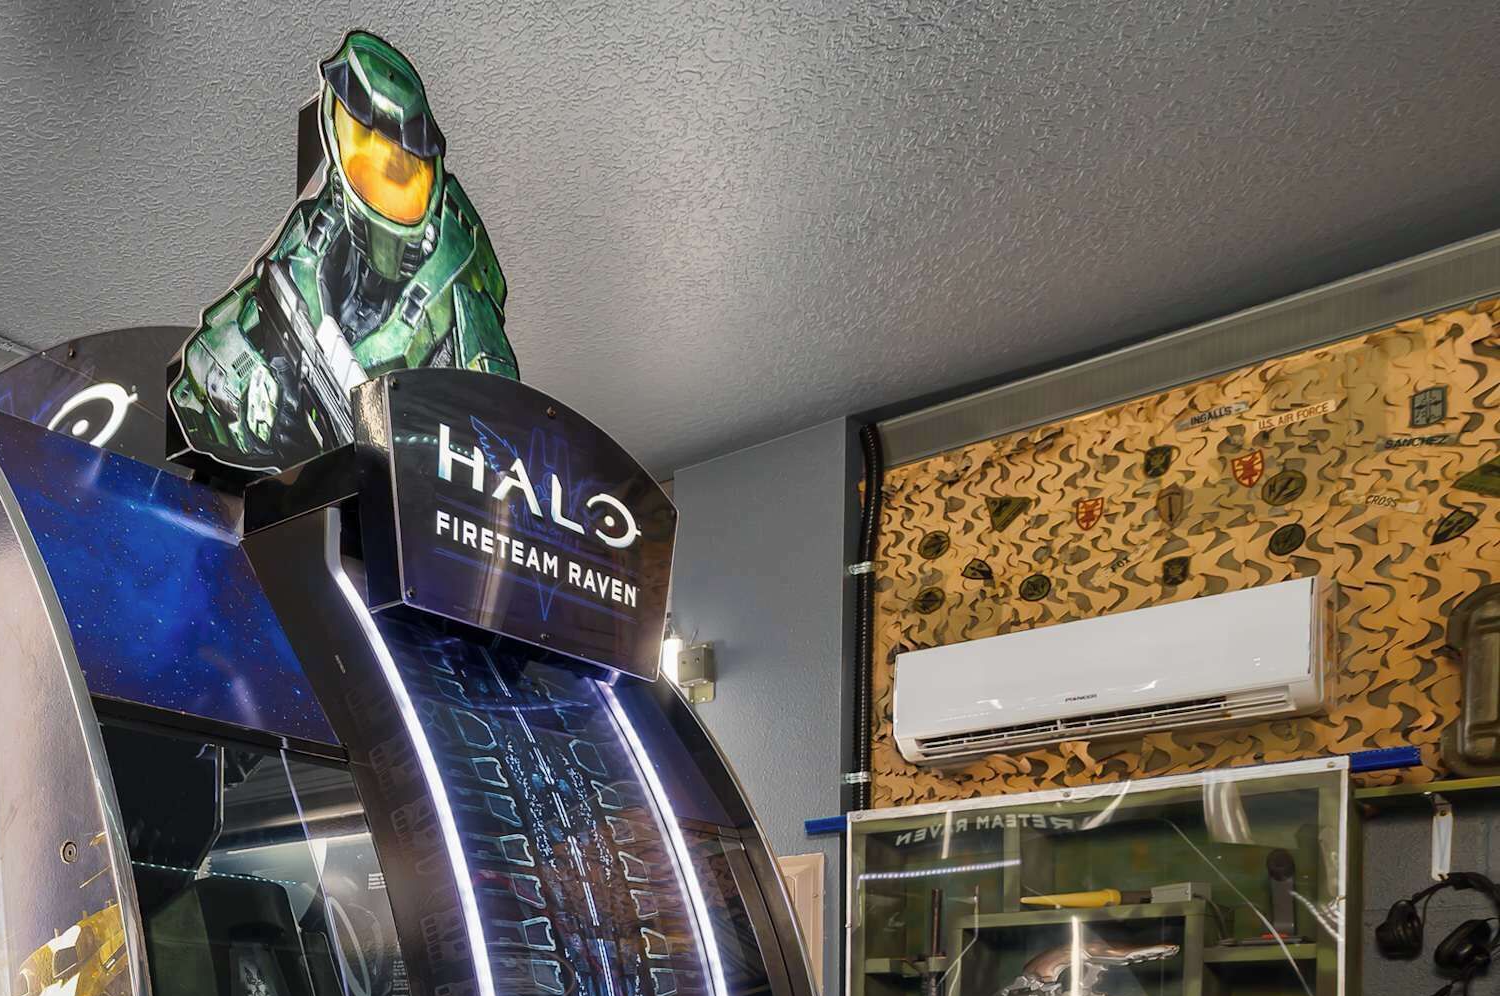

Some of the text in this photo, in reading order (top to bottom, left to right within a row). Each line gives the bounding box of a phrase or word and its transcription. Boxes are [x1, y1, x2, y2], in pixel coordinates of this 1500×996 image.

[1258, 401, 1330, 431] U.S. AIR FORCE
[437, 423, 642, 549] HALO
[436, 509, 638, 608] FIRETEAM RAVEN
